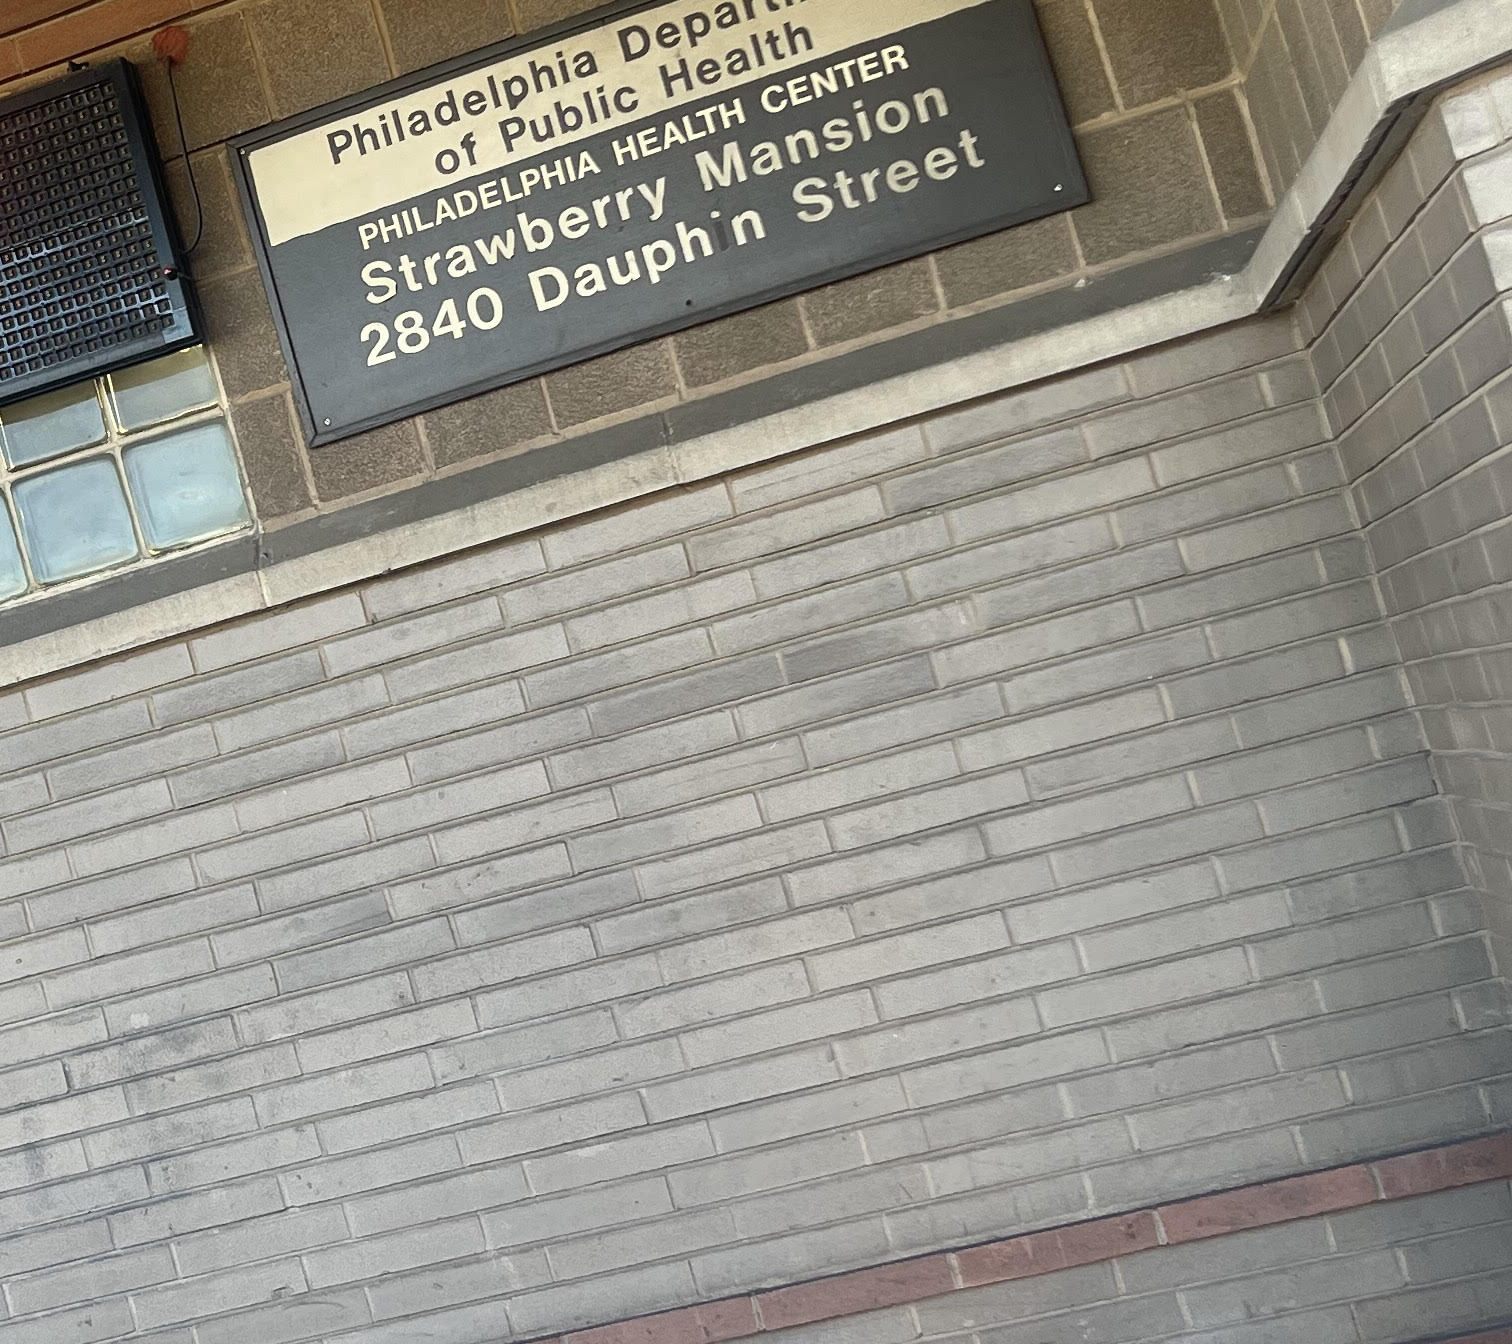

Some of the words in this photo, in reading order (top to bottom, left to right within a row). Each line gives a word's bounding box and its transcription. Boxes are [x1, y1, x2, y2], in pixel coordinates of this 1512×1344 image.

[326, 51, 598, 164] Philadelphia
[357, 151, 601, 250] PHILADELPHIA
[612, 98, 747, 168] HEALTH
[760, 43, 910, 114] CENTER
[360, 176, 667, 304] Strawberry
[695, 86, 950, 192] Mansion
[434, 131, 478, 175] of
[499, 79, 639, 155] Public
[658, 21, 814, 101] Health
[358, 286, 505, 367] 2840
[791, 128, 986, 224] Street
